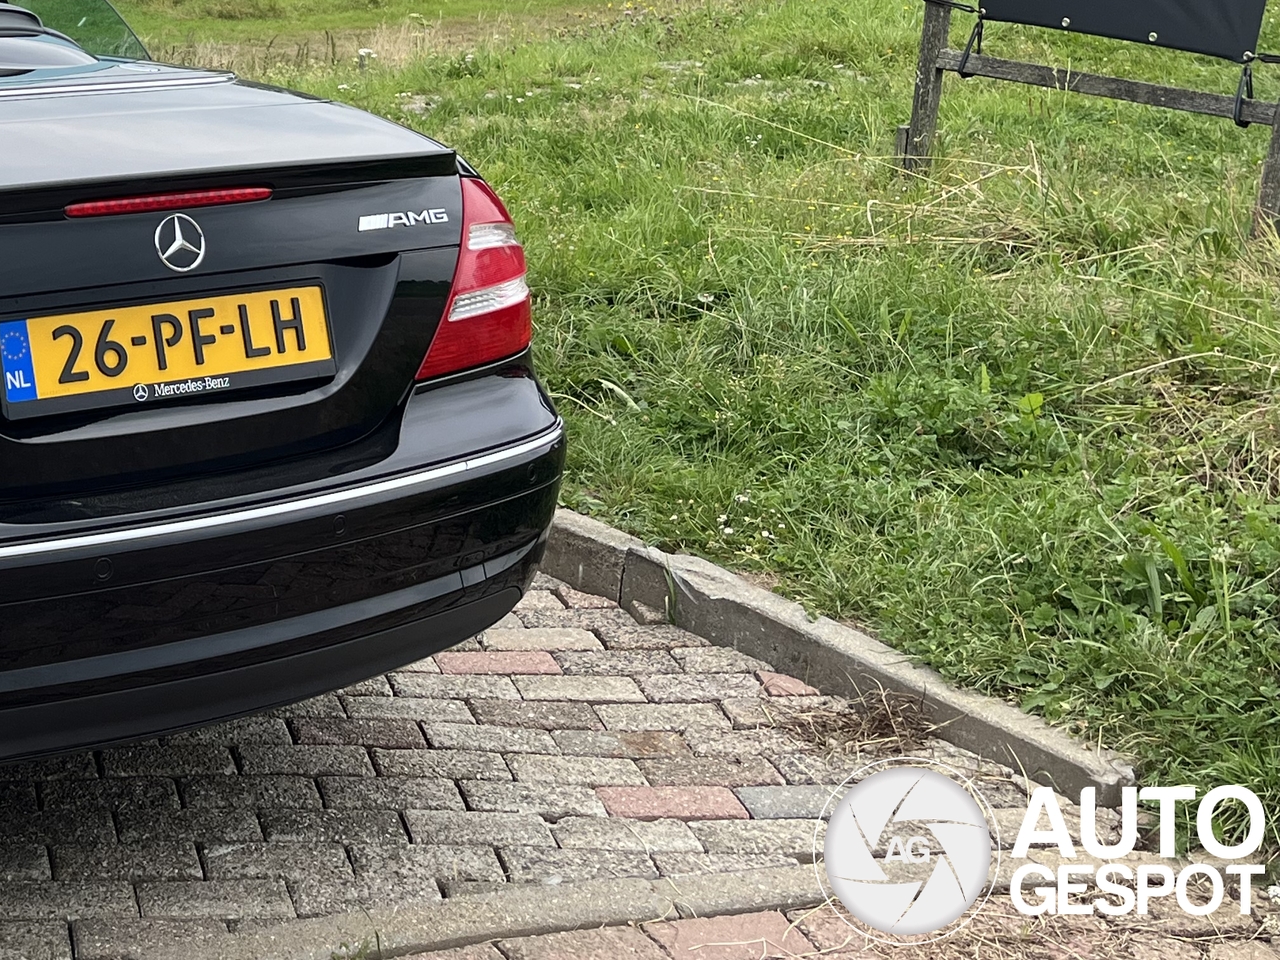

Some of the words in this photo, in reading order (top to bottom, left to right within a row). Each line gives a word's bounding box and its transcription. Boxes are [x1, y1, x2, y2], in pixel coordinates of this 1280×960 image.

[387, 208, 449, 228] AMG
[51, 297, 307, 385] 26-PF-LH
[5, 370, 31, 390] NL
[154, 376, 230, 397] Mercedes-Benz
